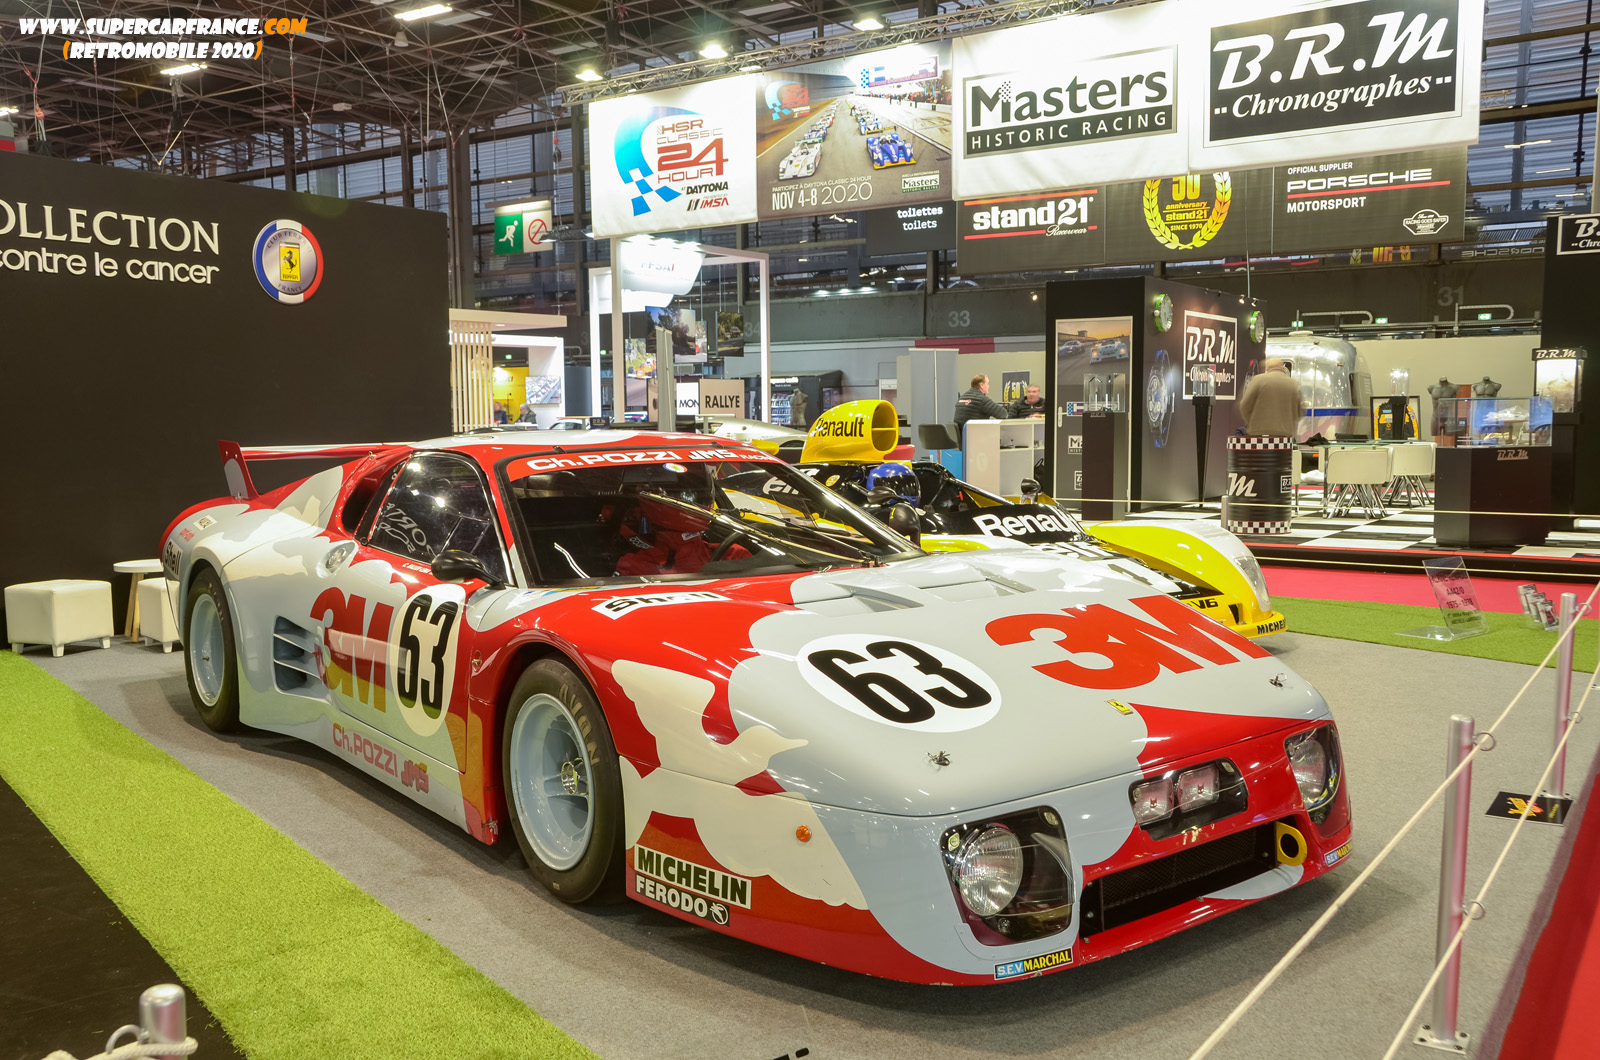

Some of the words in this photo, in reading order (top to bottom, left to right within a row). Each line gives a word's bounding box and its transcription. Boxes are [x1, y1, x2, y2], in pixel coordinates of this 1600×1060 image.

[971, 71, 1168, 127] Masters
[657, 128, 723, 145] CLASSIC
[661, 119, 704, 134] HSR
[971, 124, 1069, 149] HISTORIC
[1082, 111, 1166, 136] RACING
[657, 137, 729, 176] 24
[658, 167, 714, 184] HOUR
[1288, 165, 1318, 175] OFFICIAL
[1319, 162, 1353, 172] SUPPLIER
[686, 181, 729, 195] DAYTONA
[804, 180, 827, 188] DAYTONA
[828, 177, 849, 186] CLASSIC
[856, 175, 872, 183] HOUR
[903, 178, 939, 188] Masters
[1287, 168, 1432, 193] PORSCHE
[772, 191, 795, 210] NOV
[798, 188, 817, 207] 4-8
[822, 182, 873, 205] 2020
[1165, 201, 1208, 210] anniversary
[1287, 197, 1366, 213] MOTORSPORT
[897, 206, 943, 218] toilettes
[903, 219, 937, 230] toilets
[1046, 224, 1088, 237] Racewear
[95, 252, 118, 277] le
[126, 259, 220, 284] cancer
[949, 310, 971, 328] 33
[705, 395, 740, 409] RALLYE
[813, 416, 864, 438] Renault
[526, 451, 682, 472] Ch.POZZI
[688, 450, 740, 460] JMS
[165, 541, 182, 576] Shell
[310, 587, 394, 713] 3M
[985, 595, 1274, 690] 3M
[397, 594, 459, 720] 63
[807, 640, 993, 724] 63
[558, 683, 601, 767] AVON
[332, 722, 398, 778] Ch.POZZI
[637, 846, 748, 906] MICHELIN
[635, 875, 709, 918] FERODO
